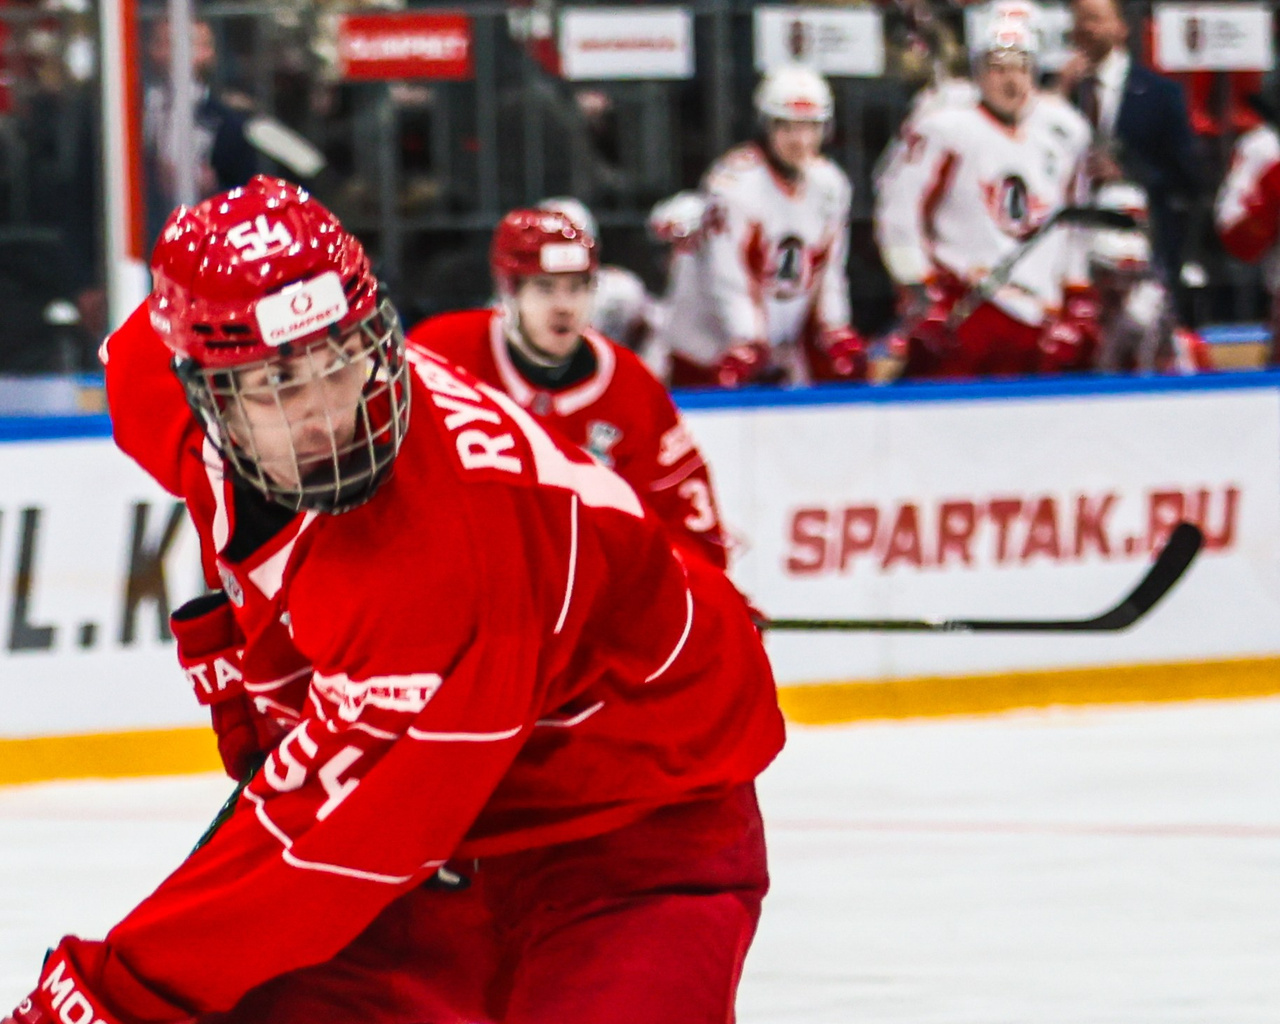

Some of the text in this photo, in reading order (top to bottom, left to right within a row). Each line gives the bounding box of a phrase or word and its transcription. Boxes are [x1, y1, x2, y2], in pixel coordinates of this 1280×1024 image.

[227, 214, 293, 262] 54
[269, 303, 342, 339] OLIMPBET
[786, 486, 1241, 576] SPARTAK.RU
